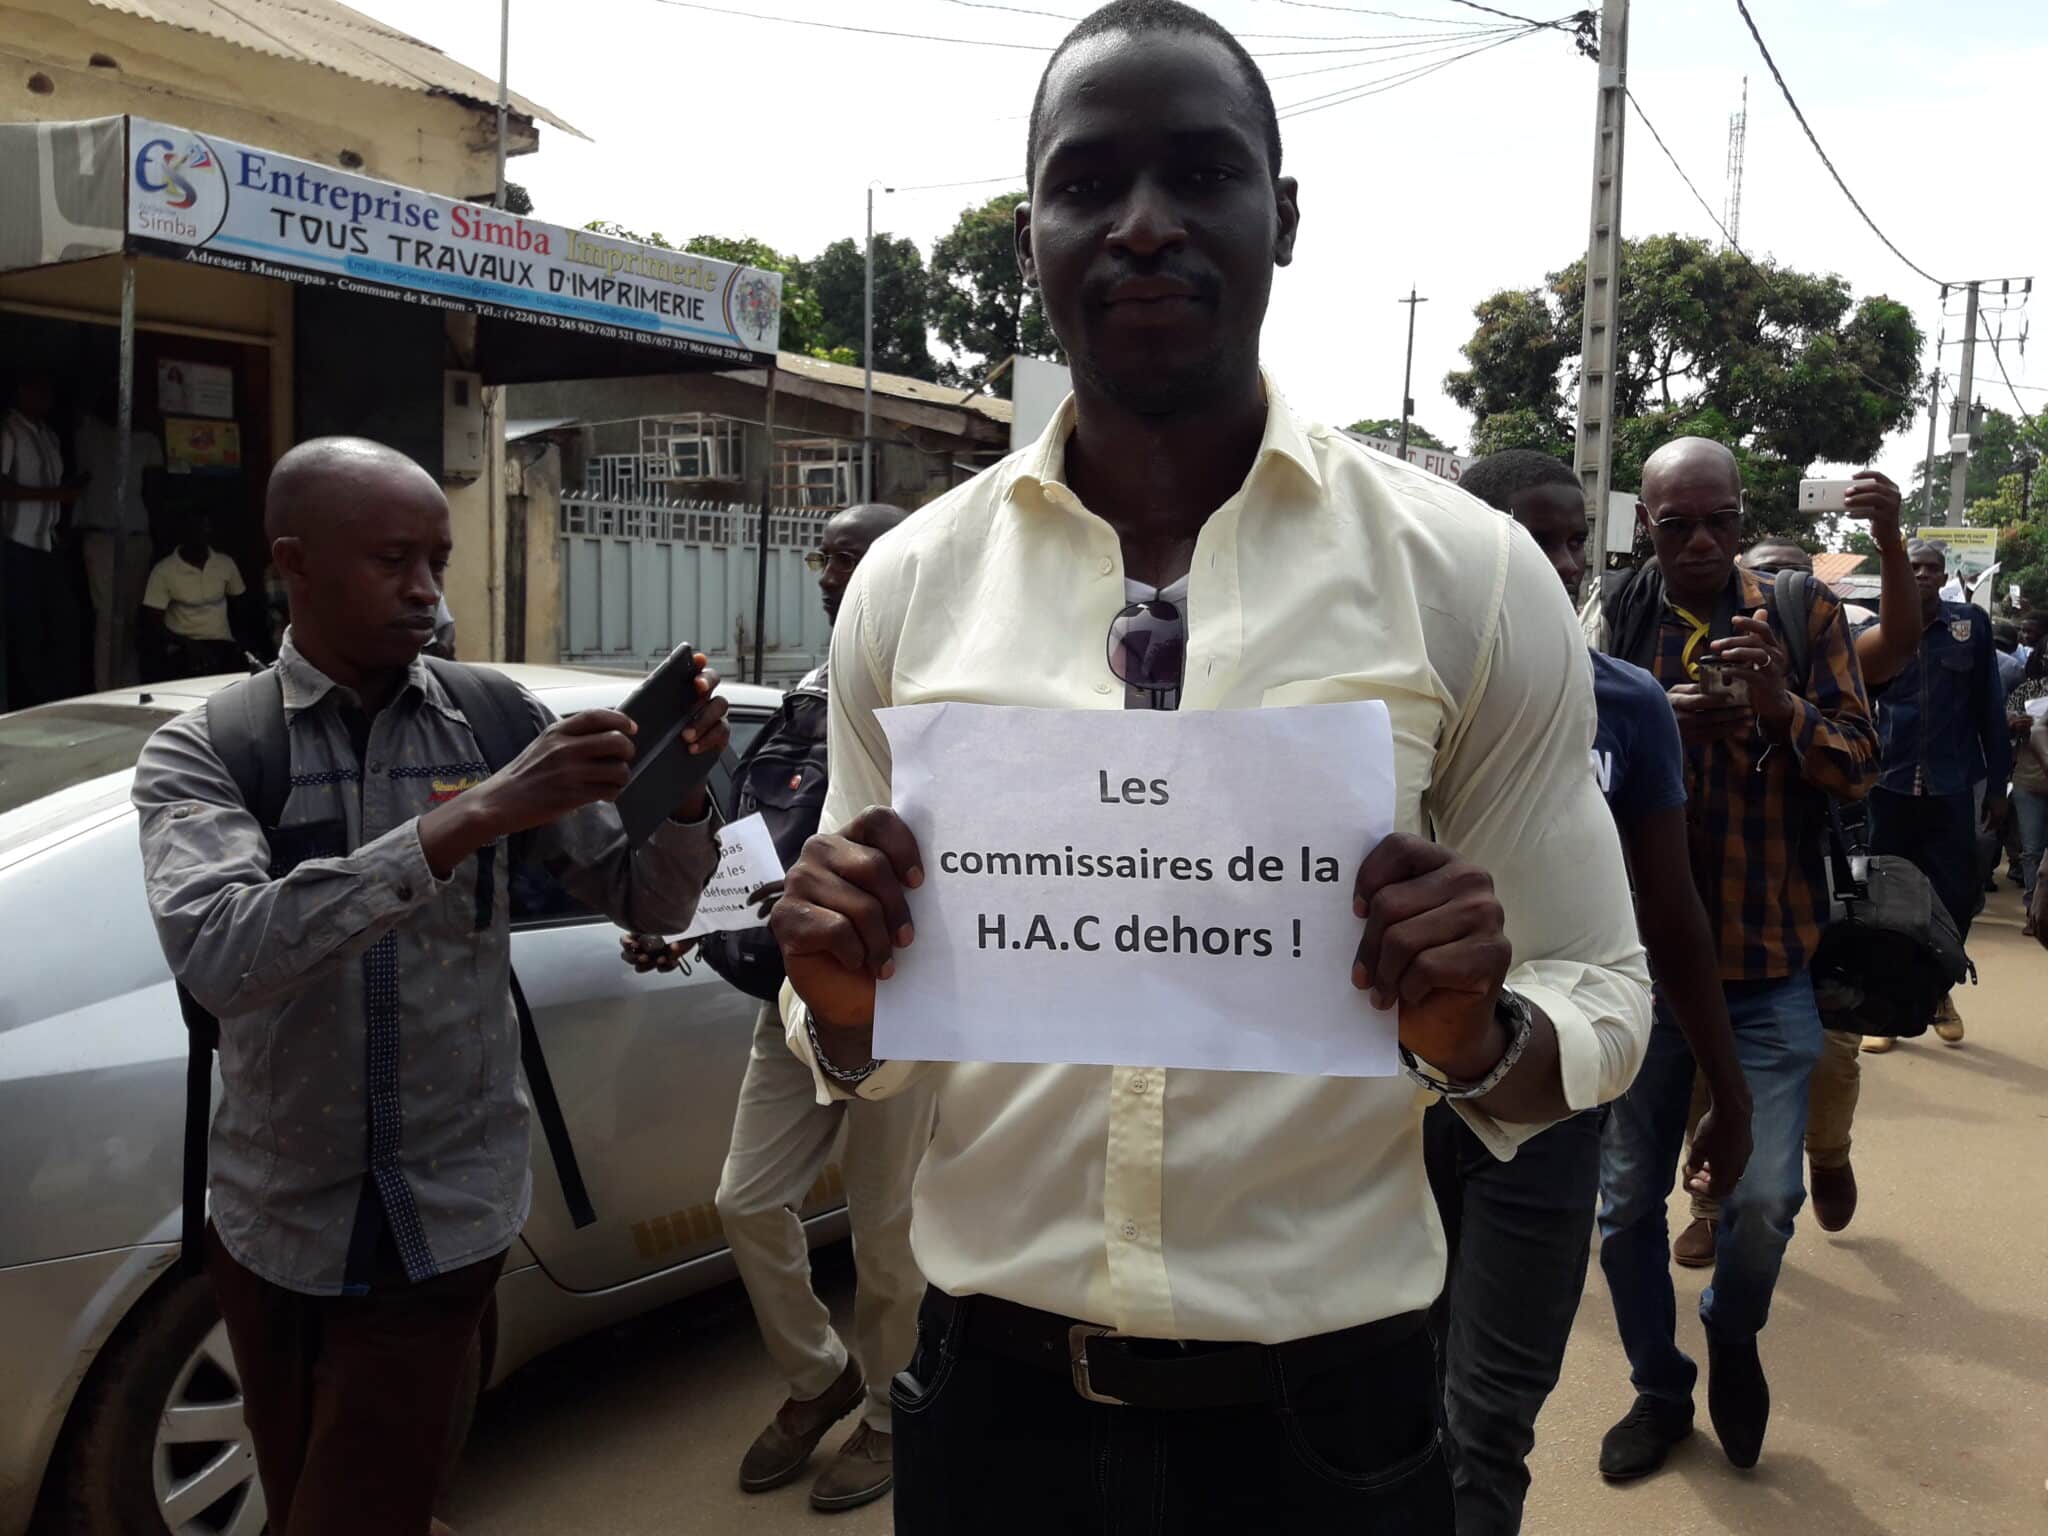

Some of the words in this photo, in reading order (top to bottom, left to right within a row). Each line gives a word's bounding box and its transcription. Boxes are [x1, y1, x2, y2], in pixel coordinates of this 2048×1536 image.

[139, 209, 197, 237] Simba
[236, 150, 440, 231] Entreprise
[451, 206, 552, 255] Simba
[564, 230, 719, 292] Imprimerie
[271, 208, 370, 254] TOUS
[388, 235, 534, 288] TRAVAUX
[549, 268, 705, 321] D'IMPRIMERIE
[185, 248, 247, 271] Adresse:
[251, 260, 327, 285] Manquepas
[337, 278, 401, 300] Commune
[403, 291, 418, 303] de
[420, 294, 466, 312] Kaloum
[503, 309, 538, 324] (+224)
[1424, 454, 1461, 481] FILS
[1098, 770, 1170, 804] Les
[721, 843, 744, 859] pas
[940, 846, 1214, 881] commissaires
[1227, 846, 1284, 882] de
[1301, 846, 1340, 882] la
[726, 865, 746, 878] les
[977, 913, 1101, 951] H.A.C
[1115, 913, 1274, 957] dehors
[1292, 918, 1302, 958] !
